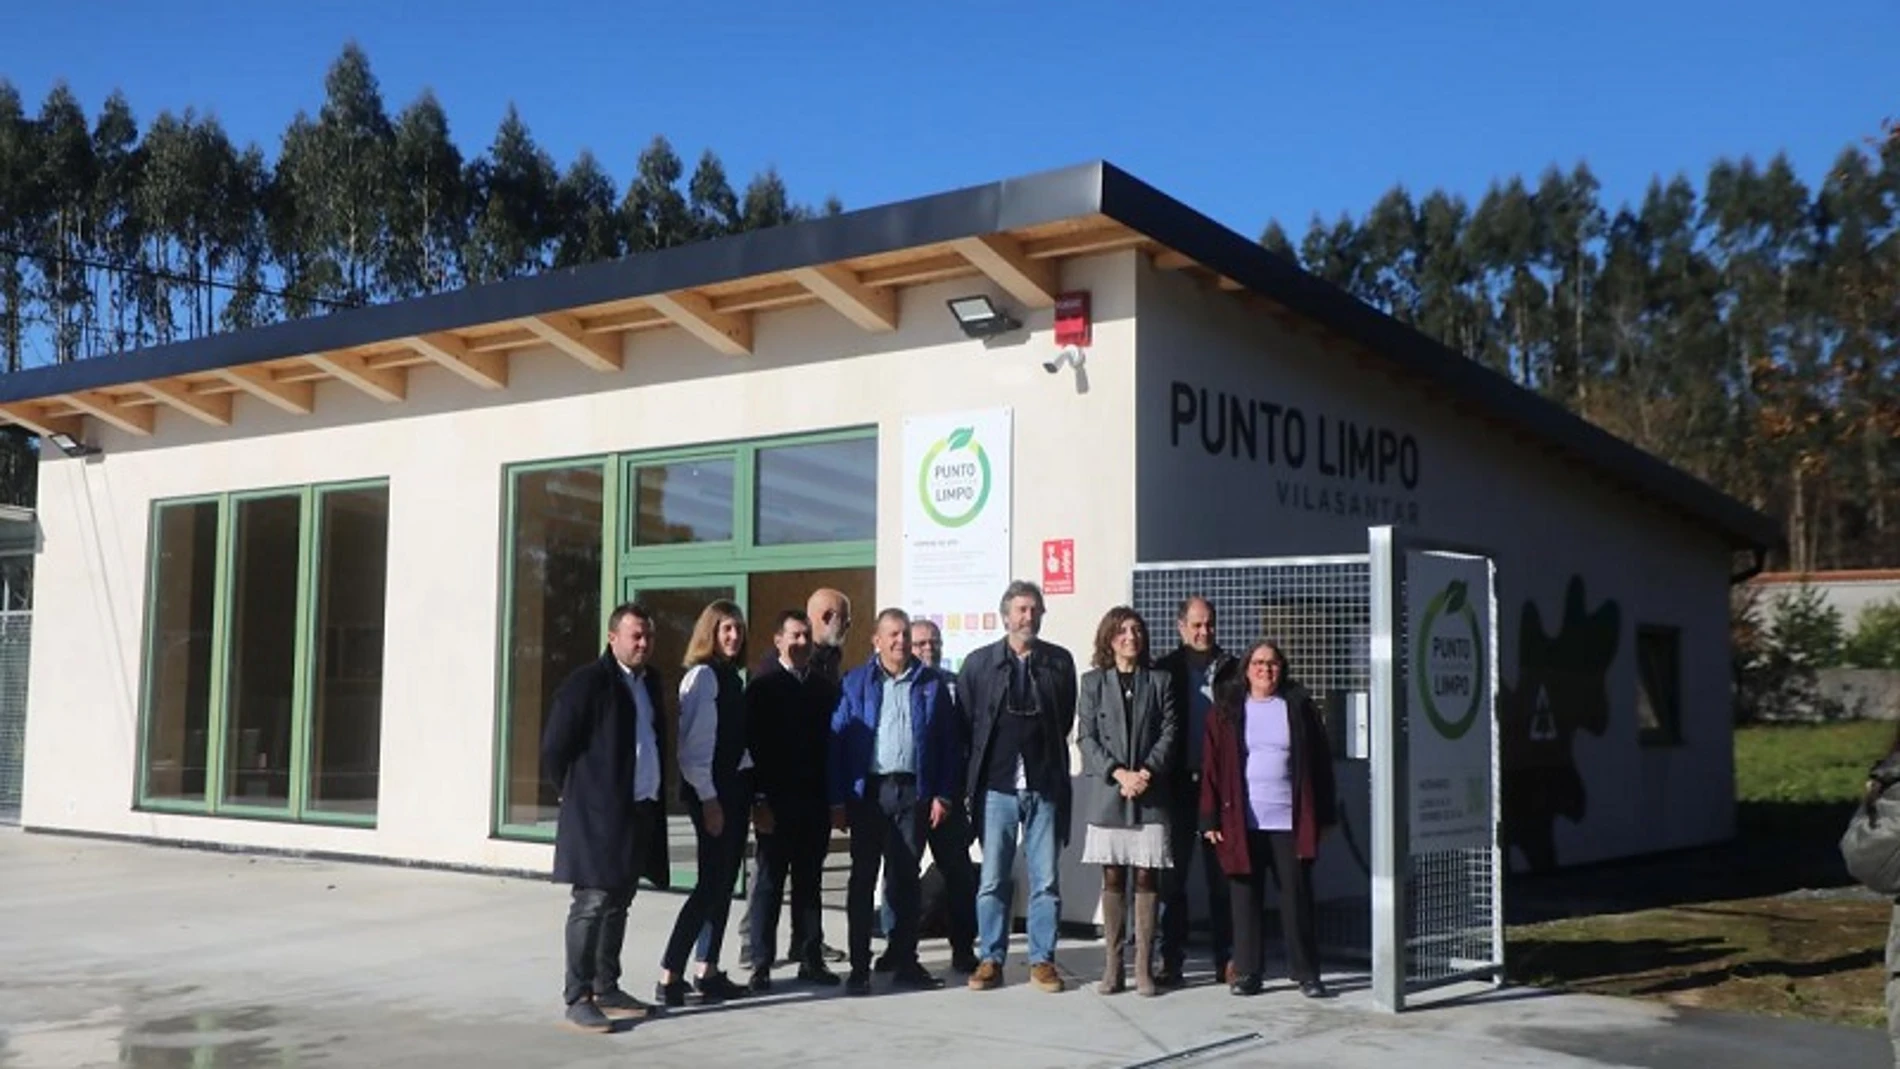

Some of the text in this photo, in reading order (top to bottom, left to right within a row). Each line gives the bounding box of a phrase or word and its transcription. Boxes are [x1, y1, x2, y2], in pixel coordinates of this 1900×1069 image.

[1171, 380, 1419, 490] PUNTO LIMPO
[935, 463, 976, 479] PUNTO
[935, 487, 974, 502] LIMPO
[1276, 480, 1419, 525] VILASANTAR
[1433, 636, 1470, 660] PUNTO
[1434, 673, 1469, 696] LIMPO
